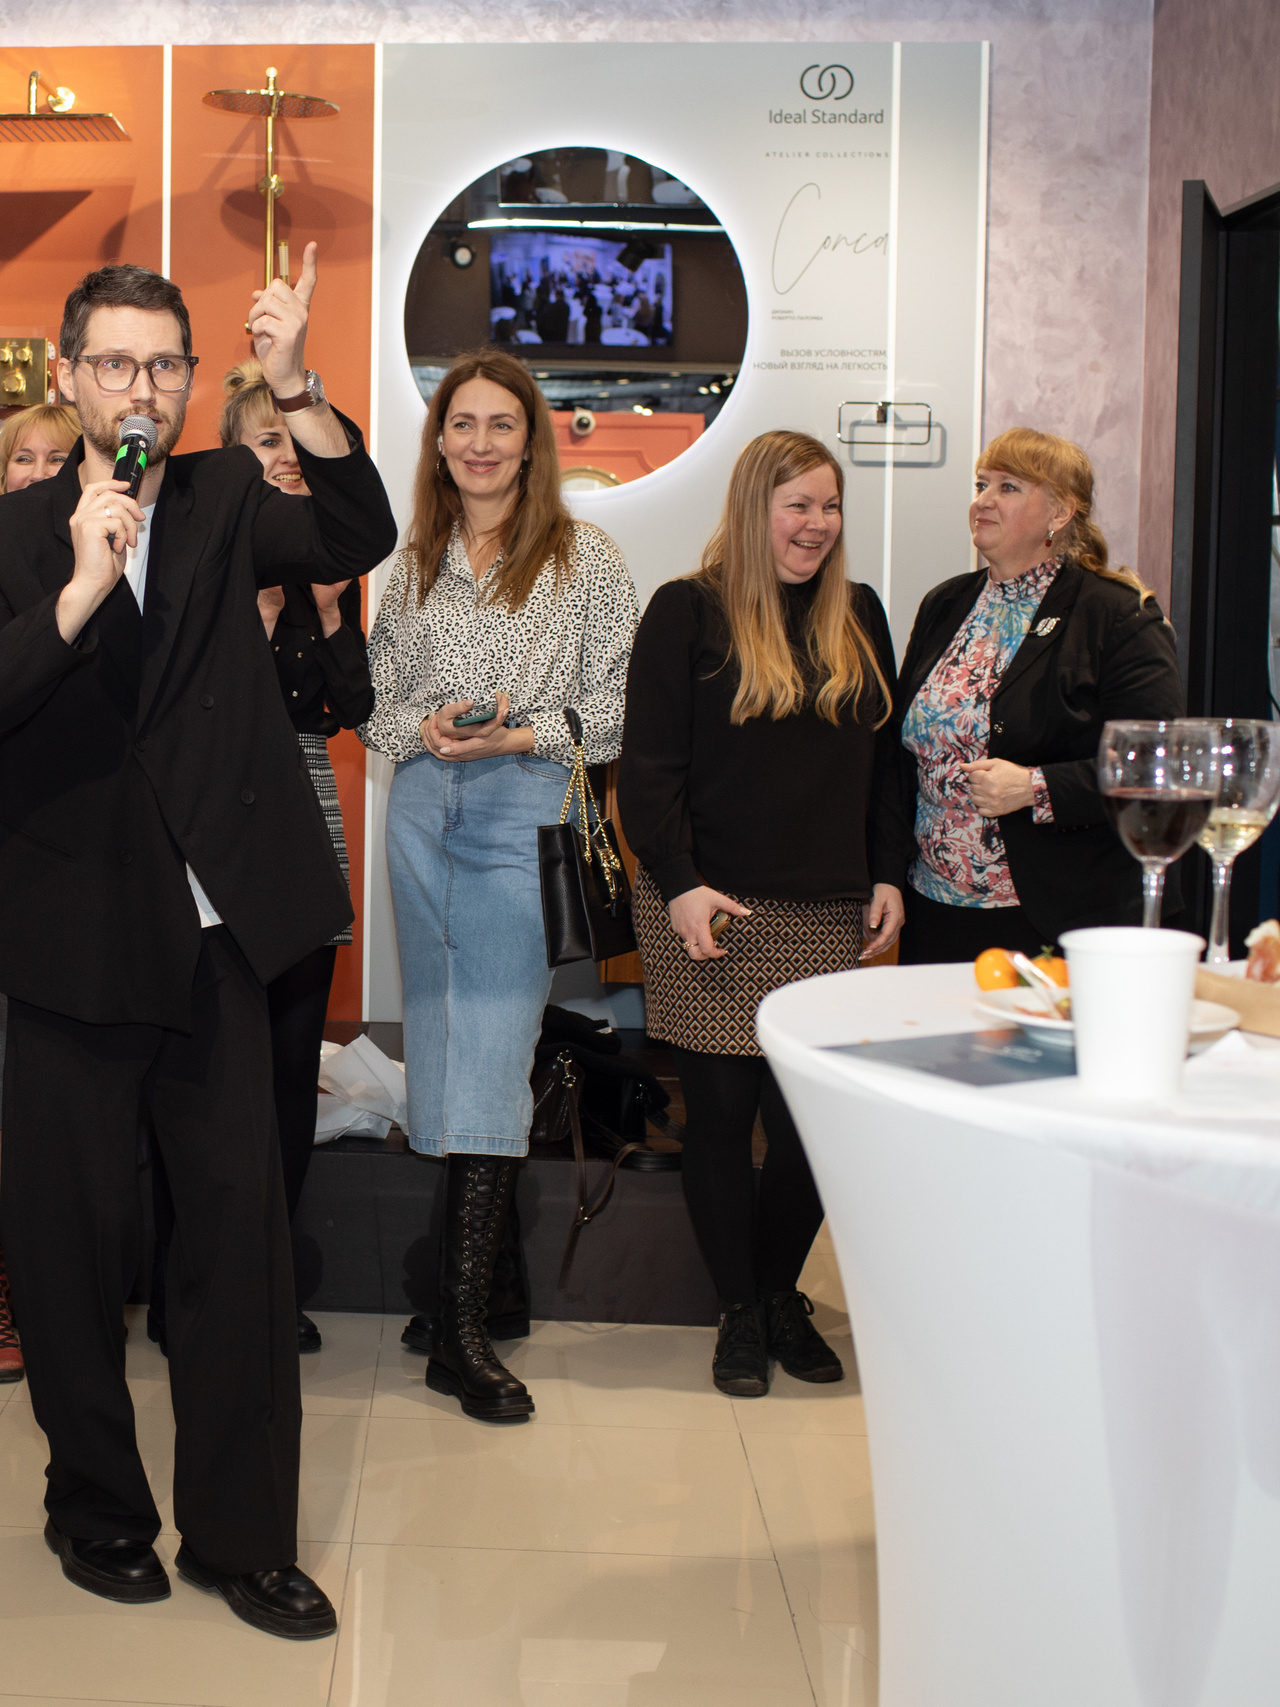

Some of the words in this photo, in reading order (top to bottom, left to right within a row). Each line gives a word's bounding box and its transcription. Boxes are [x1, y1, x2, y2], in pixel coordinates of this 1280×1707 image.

[768, 109, 808, 124] Ideal
[811, 109, 884, 124] Standard
[771, 182, 889, 295] Conca
[780, 349, 813, 358] ВЫЗОВ
[753, 361, 789, 370] НОВЫЙ
[790, 362, 824, 371] ВЗГЛЯД
[826, 362, 839, 370] НА
[841, 362, 888, 371] ЛЕГКОСТЬ
